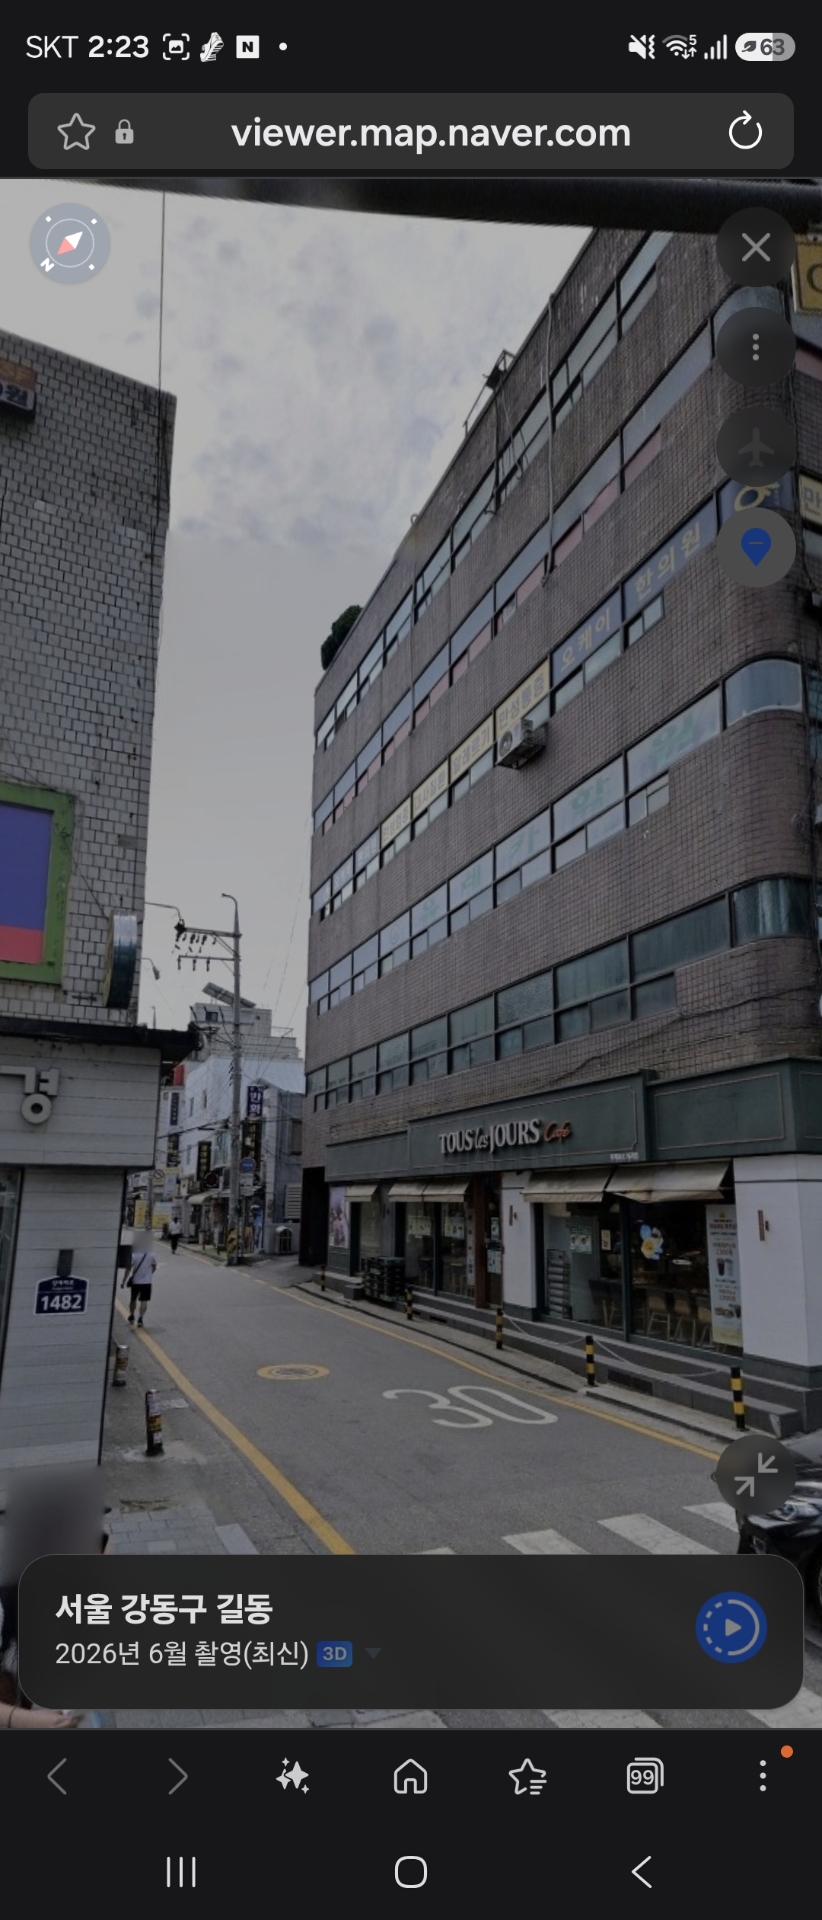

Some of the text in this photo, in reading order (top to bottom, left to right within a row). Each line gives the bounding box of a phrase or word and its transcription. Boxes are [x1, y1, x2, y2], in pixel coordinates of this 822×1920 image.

[560, 520, 701, 674] 오케이 한의원
[438, 1128, 474, 1154] TOUS
[473, 1127, 490, 1150] les
[488, 1118, 541, 1154] JOURS
[40, 1294, 83, 1311] 1482
[382, 1385, 560, 1430] 30
